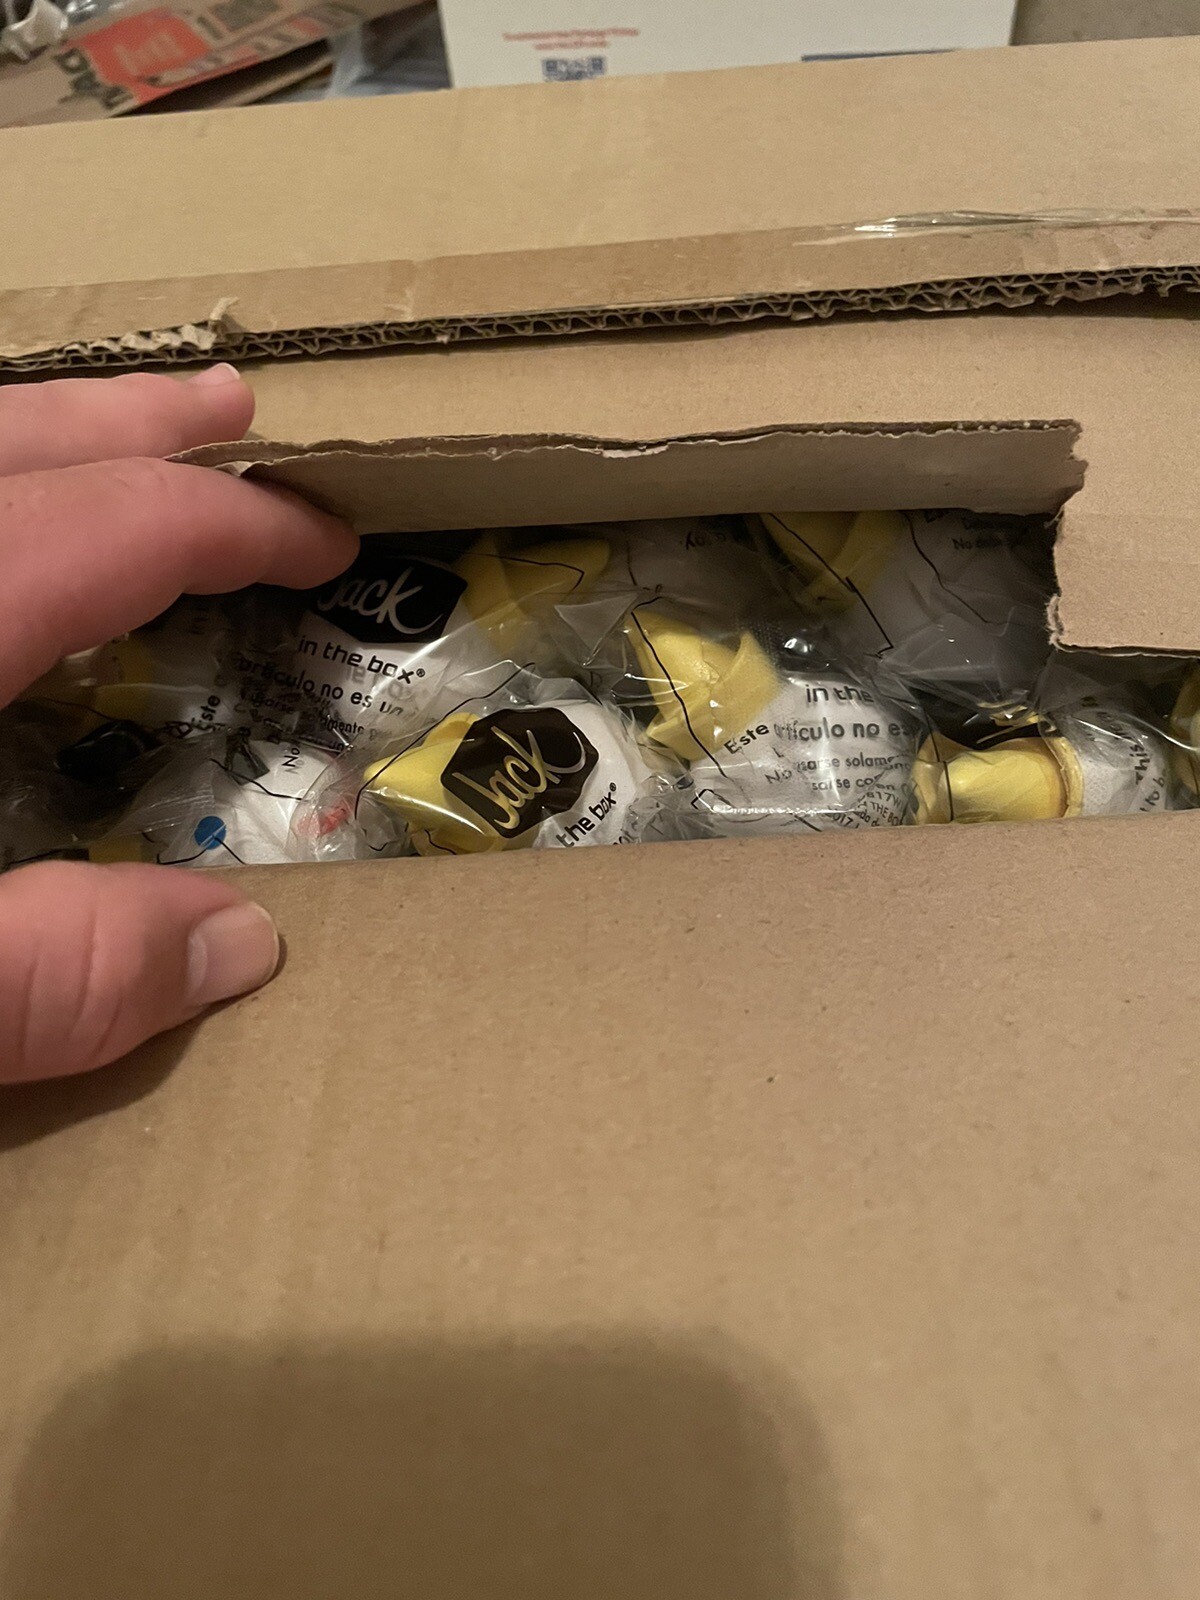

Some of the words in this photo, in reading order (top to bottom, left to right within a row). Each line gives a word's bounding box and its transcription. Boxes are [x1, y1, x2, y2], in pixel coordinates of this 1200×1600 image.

[300, 635, 317, 656] in
[323, 641, 363, 668] the
[320, 682, 344, 700] no
[350, 690, 373, 709] es
[805, 684, 829, 703] in
[833, 685, 875, 703] the
[723, 723, 770, 755] Este
[852, 722, 880, 739] no
[452, 725, 587, 830] Jack
[764, 768, 793, 785] No
[1129, 744, 1151, 786] This
[555, 816, 596, 848] the
